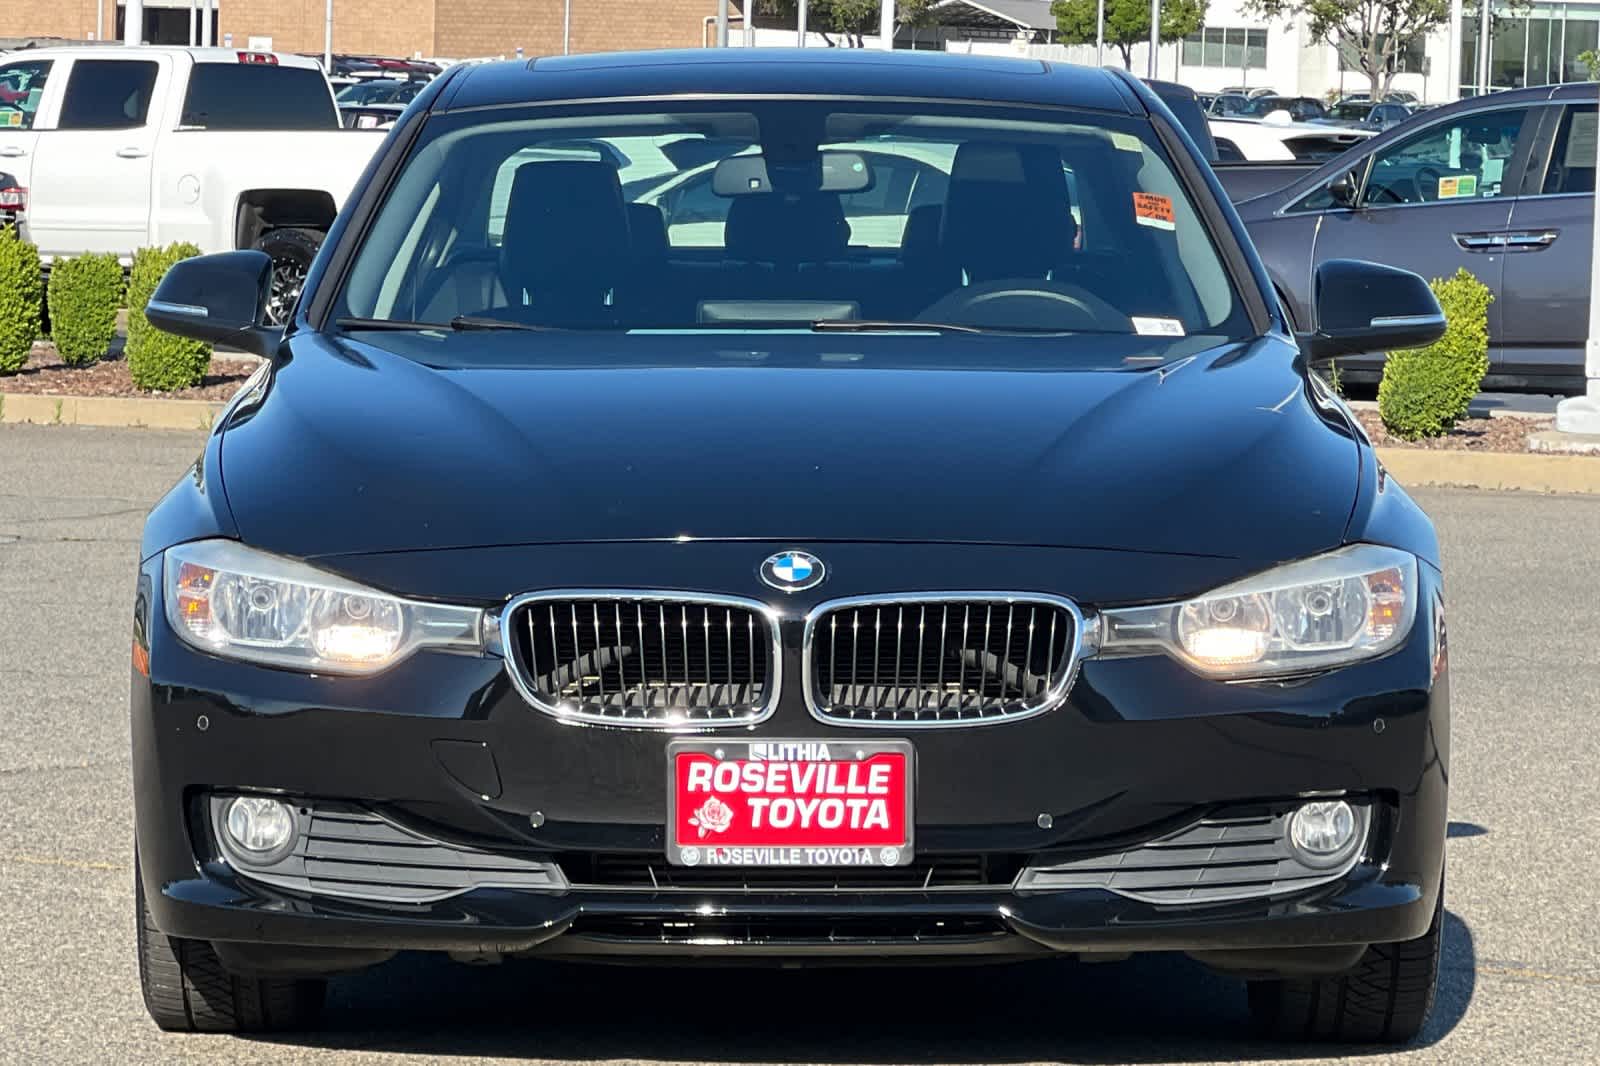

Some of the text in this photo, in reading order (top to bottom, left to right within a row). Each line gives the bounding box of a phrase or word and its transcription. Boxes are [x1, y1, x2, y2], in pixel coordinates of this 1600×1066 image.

[767, 744, 831, 761] LITHIA
[687, 762, 891, 794] ROSEVILLE
[747, 798, 889, 829] TOYOTA
[706, 848, 873, 865] ROSEVILLE TOYOTA
